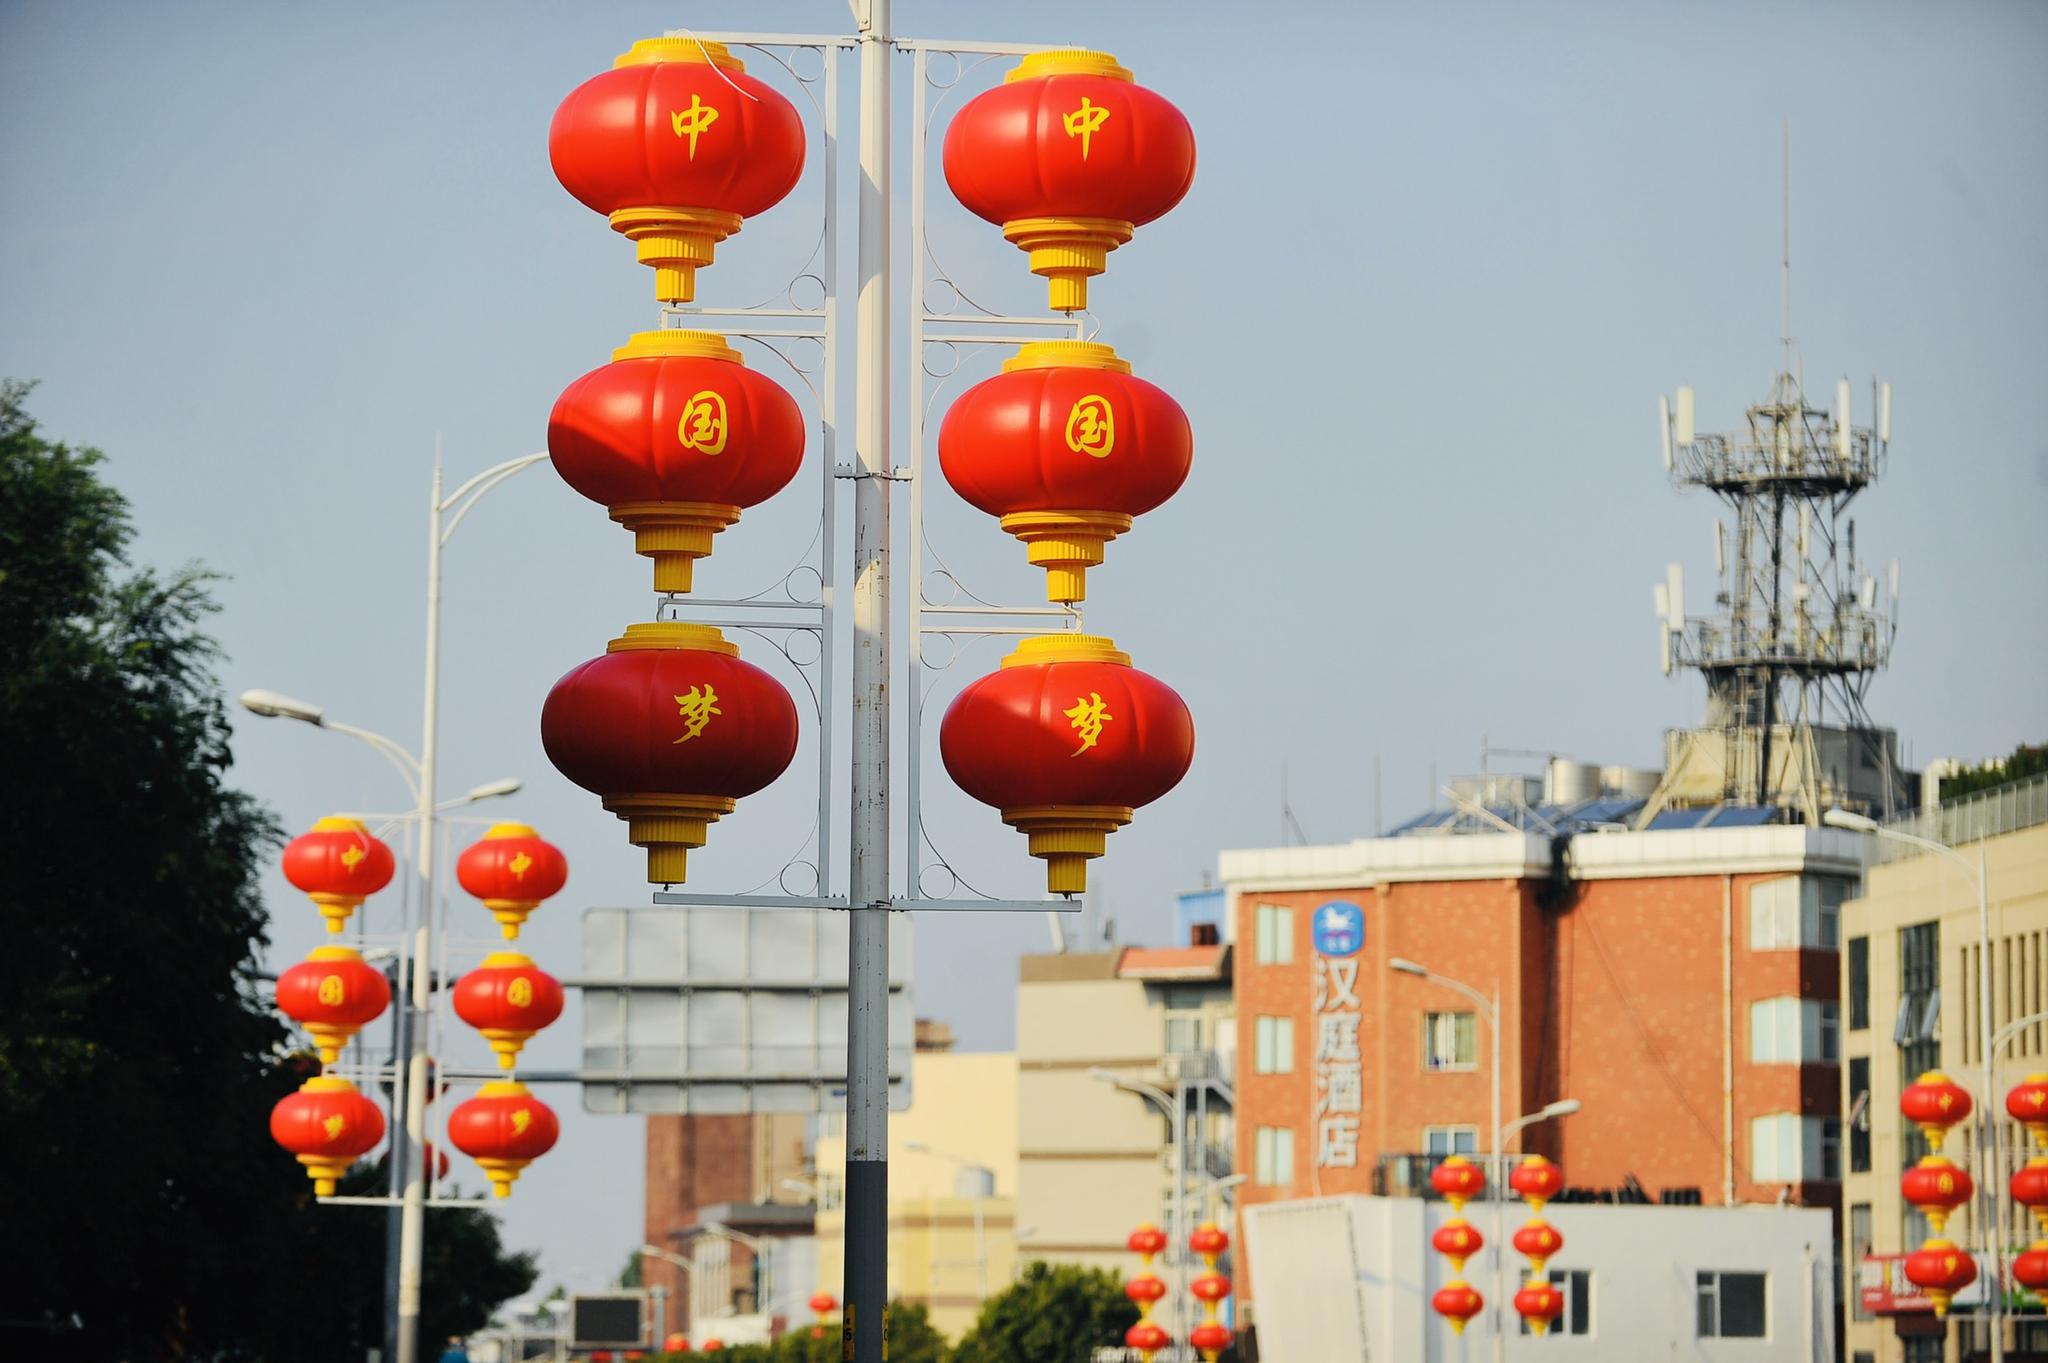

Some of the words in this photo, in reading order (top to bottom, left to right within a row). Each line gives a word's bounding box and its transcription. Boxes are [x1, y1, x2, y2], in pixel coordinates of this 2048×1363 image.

[670, 94, 719, 162] 中
[1063, 96, 1110, 161] 中
[677, 390, 728, 455] 国
[1064, 394, 1115, 458] 国
[672, 683, 722, 745] 梦
[1063, 692, 1112, 758] 梦
